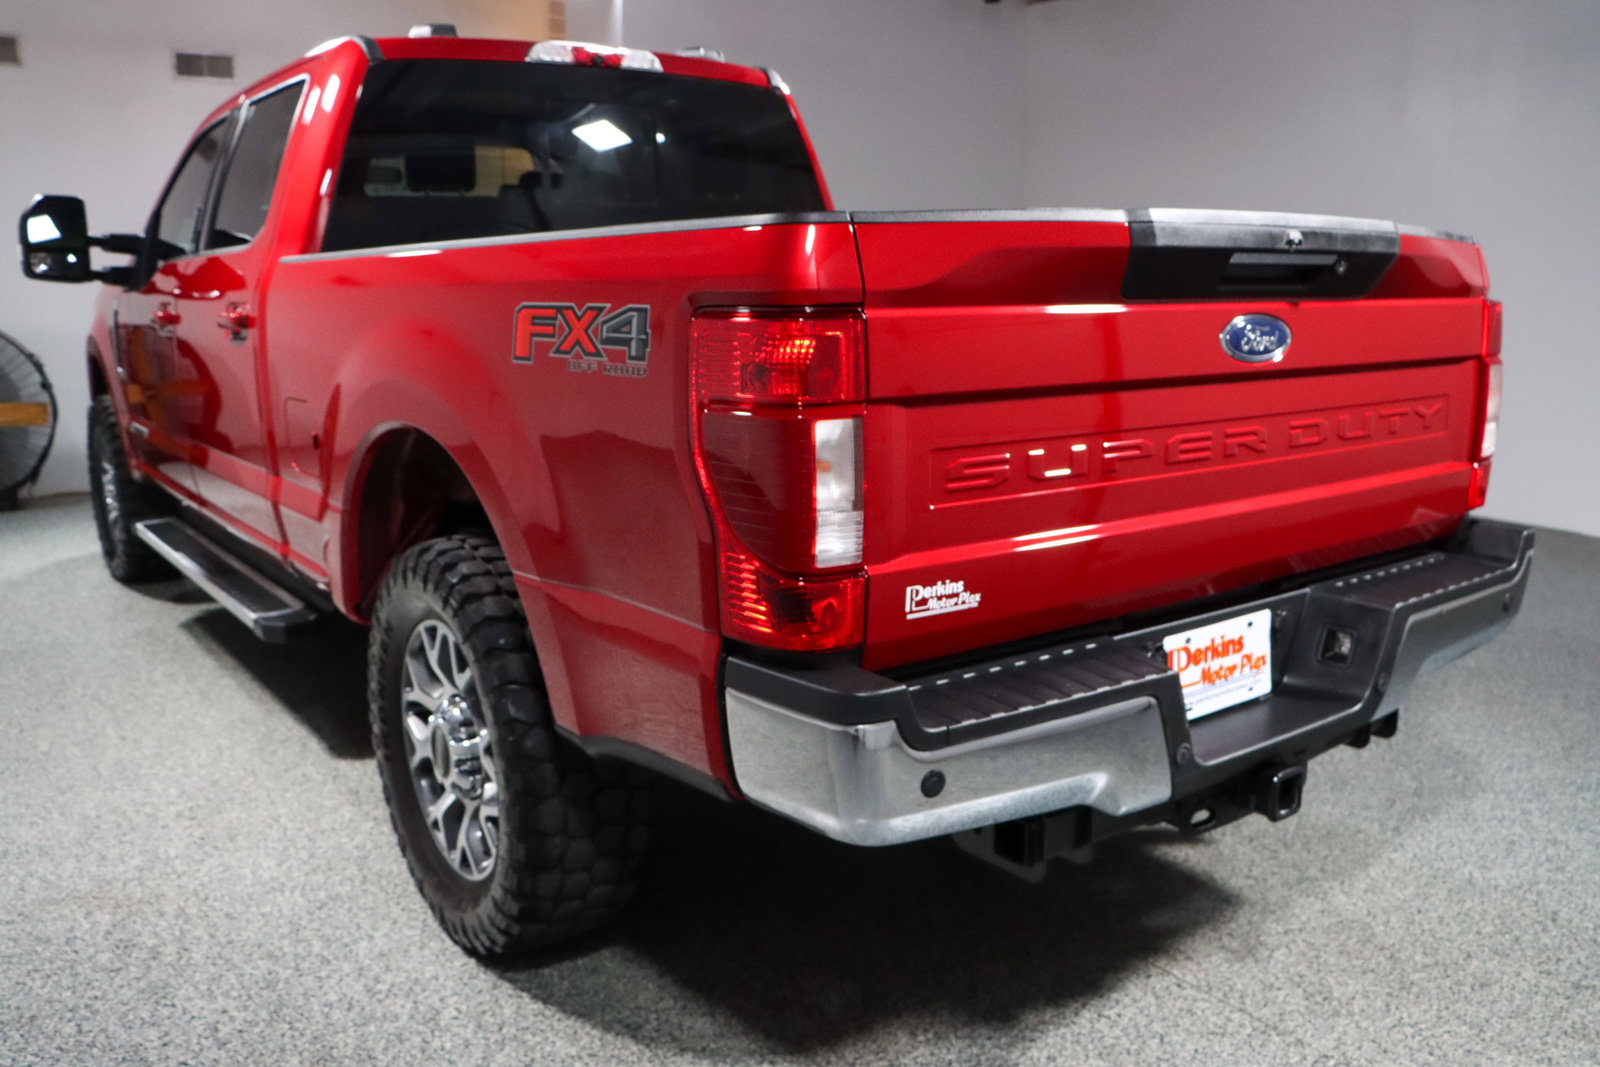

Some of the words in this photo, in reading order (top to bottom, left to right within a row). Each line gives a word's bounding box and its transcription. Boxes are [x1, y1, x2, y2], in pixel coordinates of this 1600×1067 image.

[513, 302, 651, 364] FX4
[1241, 325, 1279, 352] Ford
[567, 360, 599, 373] OFF
[602, 363, 647, 378] ROAD
[946, 424, 1267, 492] SUPER
[1289, 402, 1443, 448] DUTY
[905, 580, 964, 612] Perkins
[928, 597, 958, 610] Motor
[958, 591, 981, 605] Plex
[1167, 635, 1243, 674] Perkins
[1201, 664, 1238, 685] Motor
